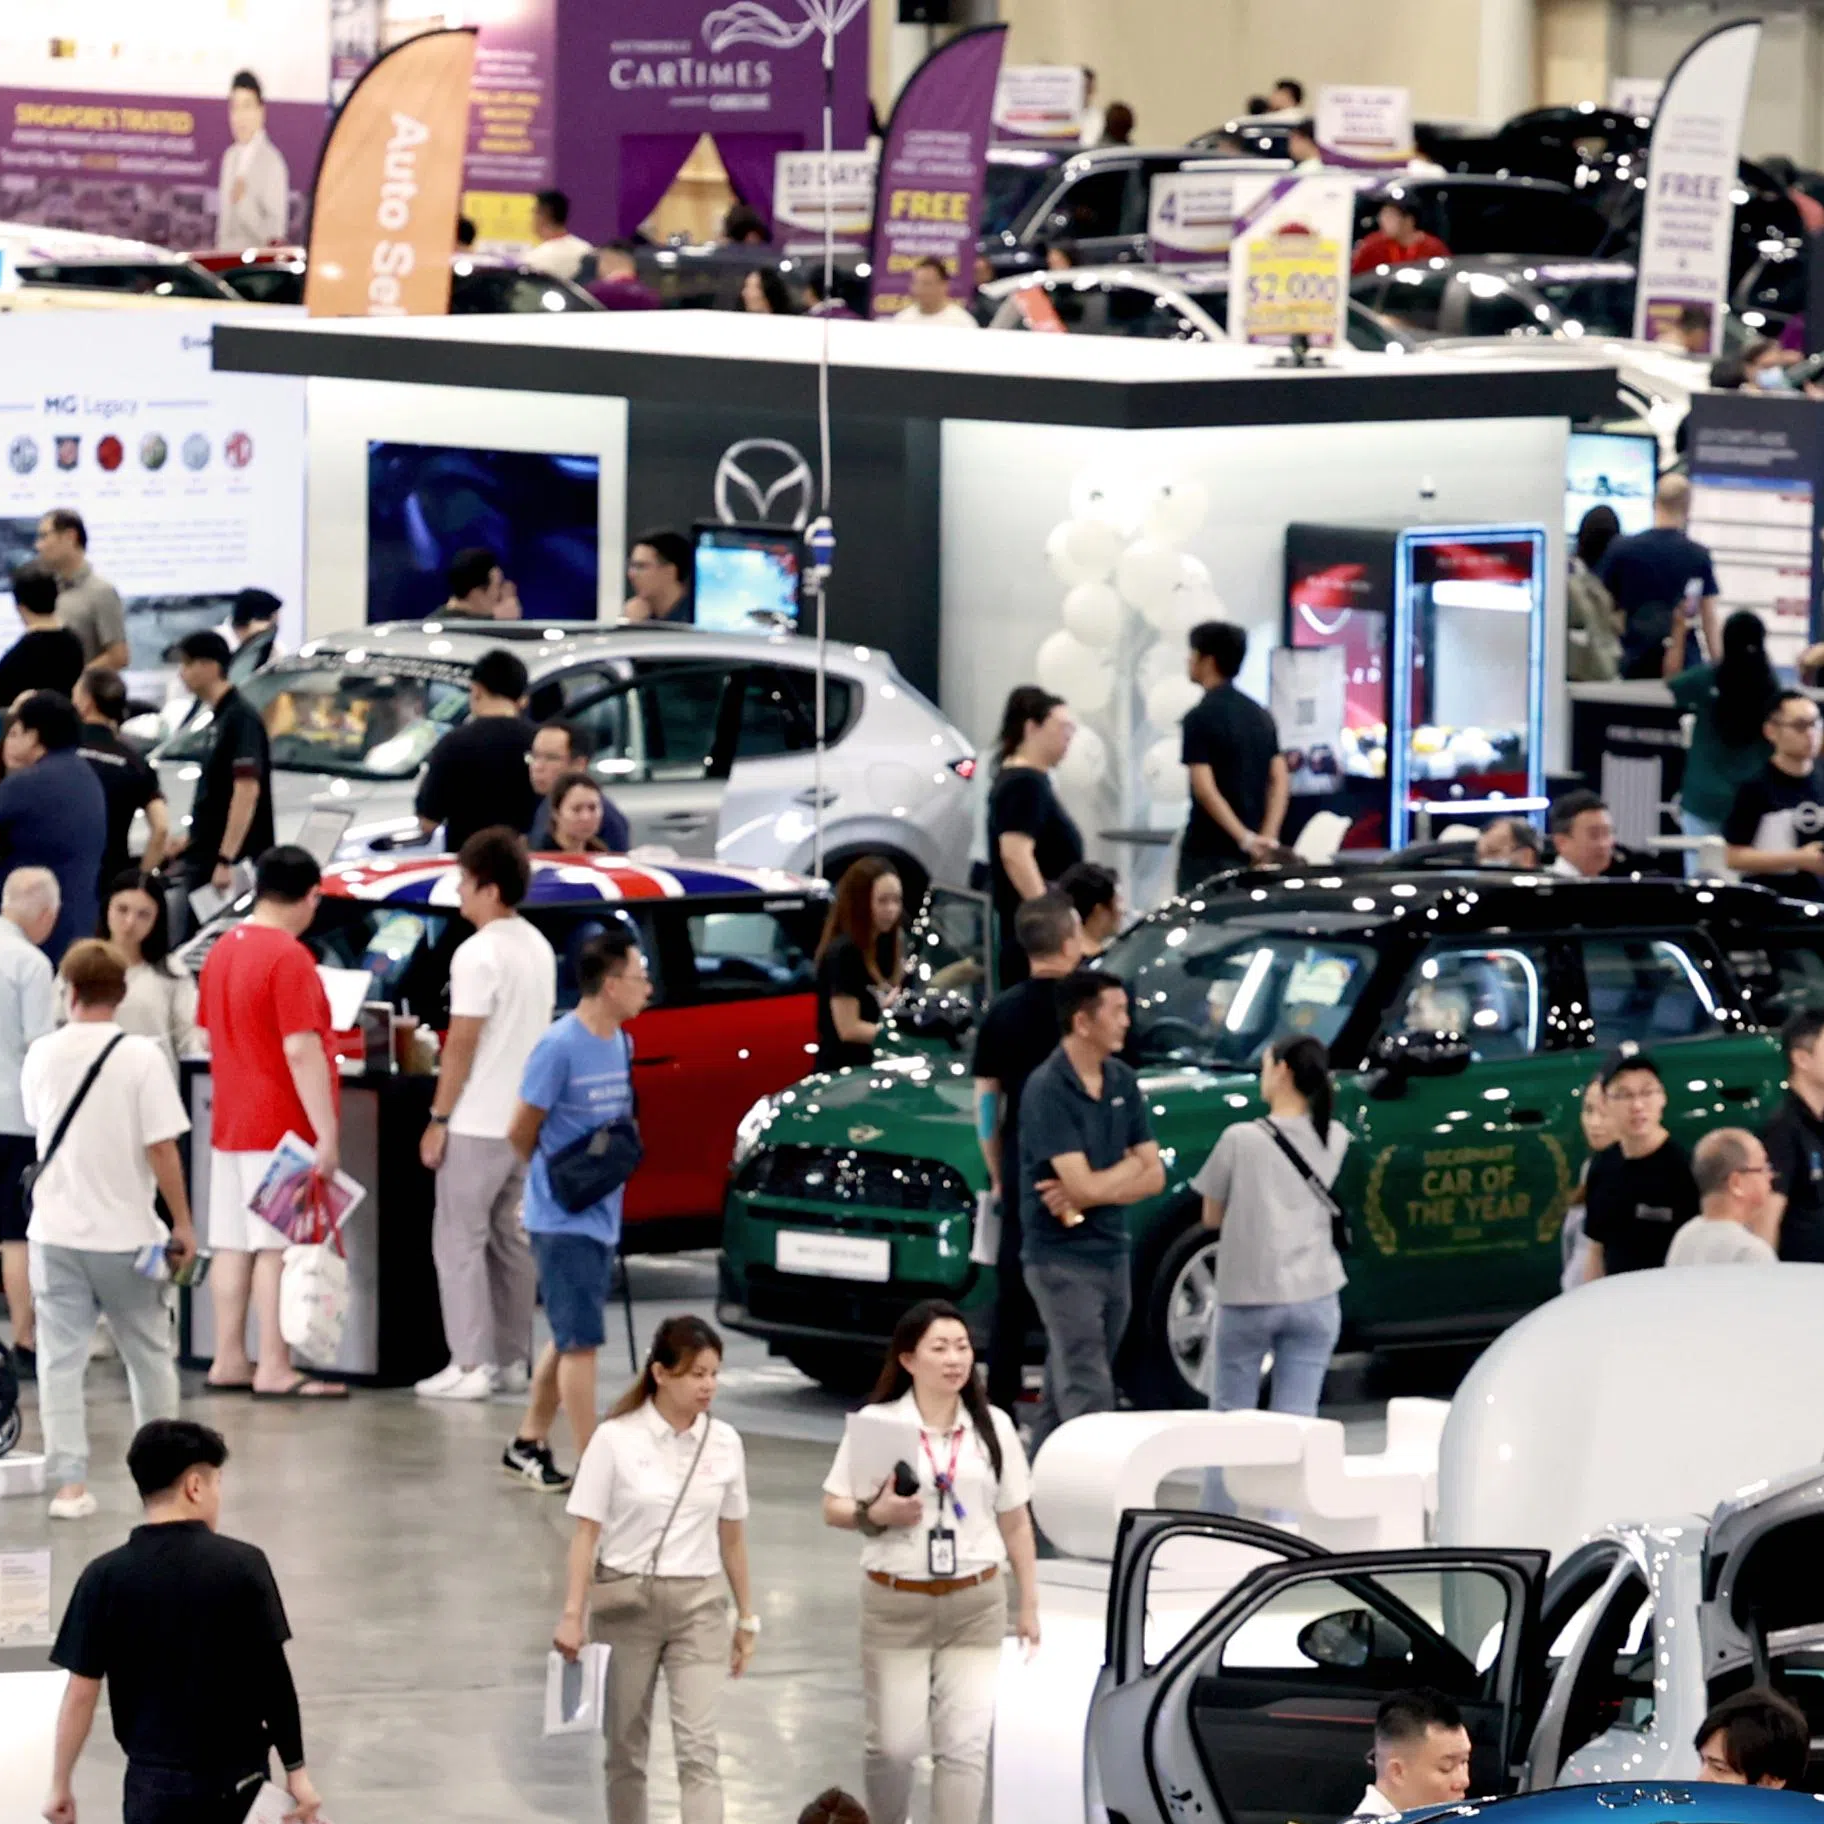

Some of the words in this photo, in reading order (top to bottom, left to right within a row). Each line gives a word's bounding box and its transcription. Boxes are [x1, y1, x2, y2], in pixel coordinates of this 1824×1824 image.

[377, 113, 429, 231] Auto
[1658, 172, 1721, 200] FREE
[889, 189, 972, 222] FREE
[44, 395, 78, 415] MG
[83, 394, 139, 419] Legacy
[1421, 1167, 1473, 1196] CAR
[1480, 1164, 1517, 1193] OF
[1405, 1199, 1454, 1224] THE
[1463, 1193, 1532, 1222] YEAR
